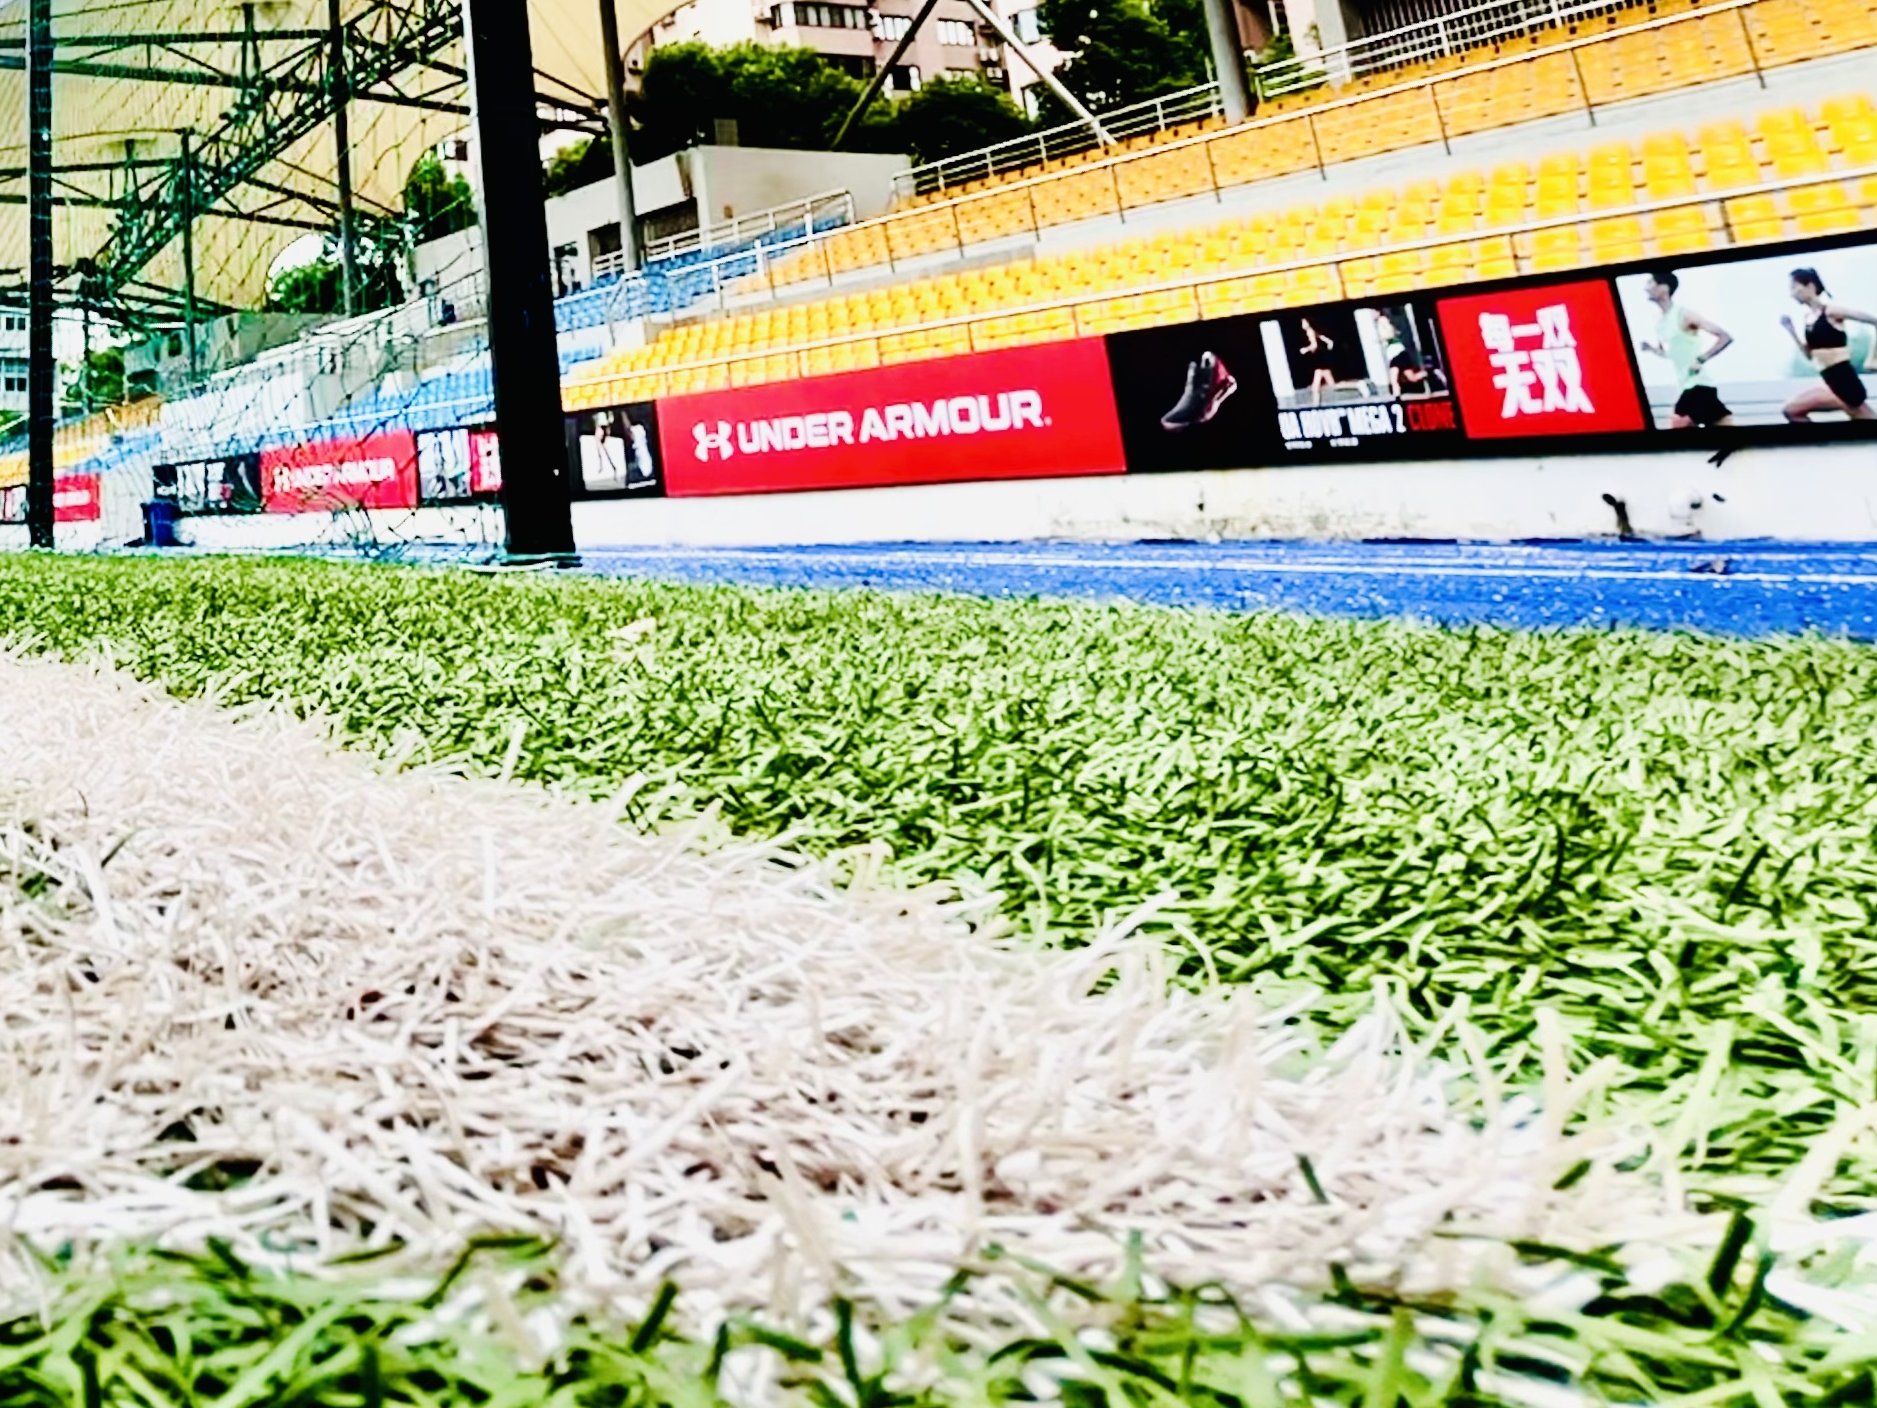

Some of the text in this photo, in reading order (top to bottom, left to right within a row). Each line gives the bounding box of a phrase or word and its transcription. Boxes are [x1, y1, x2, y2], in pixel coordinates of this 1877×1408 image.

[1478, 303, 1577, 353] 每一双
[1489, 347, 1595, 419] 无双
[737, 410, 854, 454] UNDER
